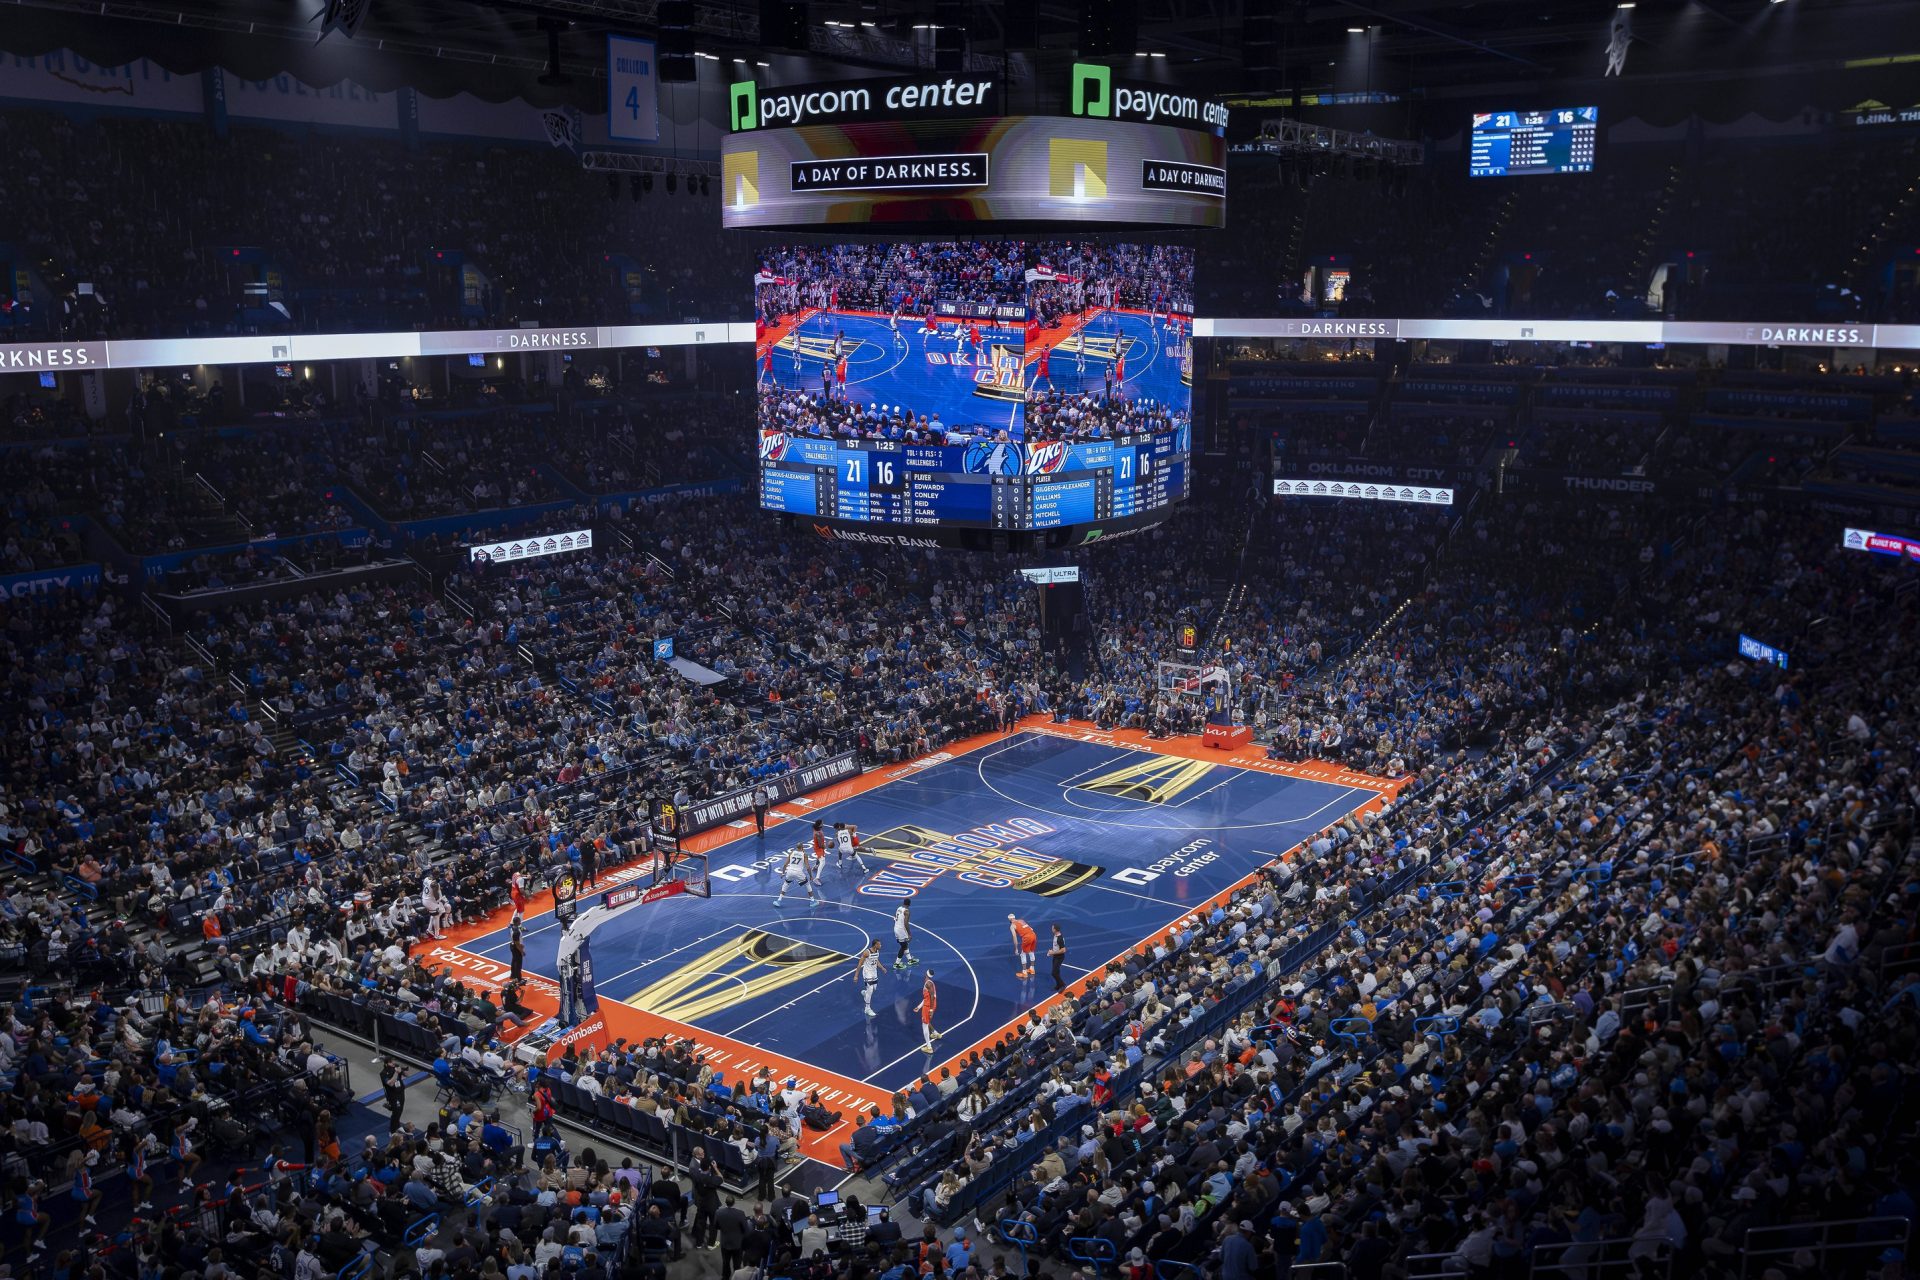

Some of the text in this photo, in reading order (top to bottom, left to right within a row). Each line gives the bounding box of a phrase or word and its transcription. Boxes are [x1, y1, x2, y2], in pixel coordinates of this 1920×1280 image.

[625, 86, 640, 120] 4
[760, 77, 992, 127] paycom center
[1114, 83, 1230, 128] paycom center
[1496, 116, 1510, 126] 21
[1558, 112, 1574, 123] 16
[798, 162, 977, 184] A DAY OF DARKNESS.
[1148, 168, 1156, 181] A
[1160, 168, 1179, 182] DAY
[1181, 170, 1193, 184] OF
[511, 332, 591, 348] DARKNESS.
[1301, 323, 1390, 336] DARKNESS.
[1762, 328, 1864, 344] DARKNESS.
[846, 440, 894, 450] 1ST 1:25
[1121, 437, 1131, 445] 1ST
[847, 460, 894, 484] 21 16
[1121, 453, 1149, 479] 21 16
[1308, 461, 1446, 480] OKLAHOM CITY
[1563, 476, 1656, 493] THUNDER
[1036, 519, 1060, 527] WILLIAMS
[801, 757, 855, 786] TAP INTO THE GAME
[1228, 757, 1395, 789] OKLAHOMA CITY THUNDER
[694, 808, 708, 824] TAP
[706, 802, 725, 821] INTO
[723, 798, 738, 815] THE
[839, 835, 849, 844] 10
[791, 856, 802, 865] 27
[857, 817, 1057, 898] OKLAHOMA
[957, 845, 1064, 888] CITY
[1146, 838, 1213, 873] paycom
[1173, 850, 1221, 878] center
[430, 947, 499, 975] ULTRA
[561, 1020, 604, 1046] coinbase
